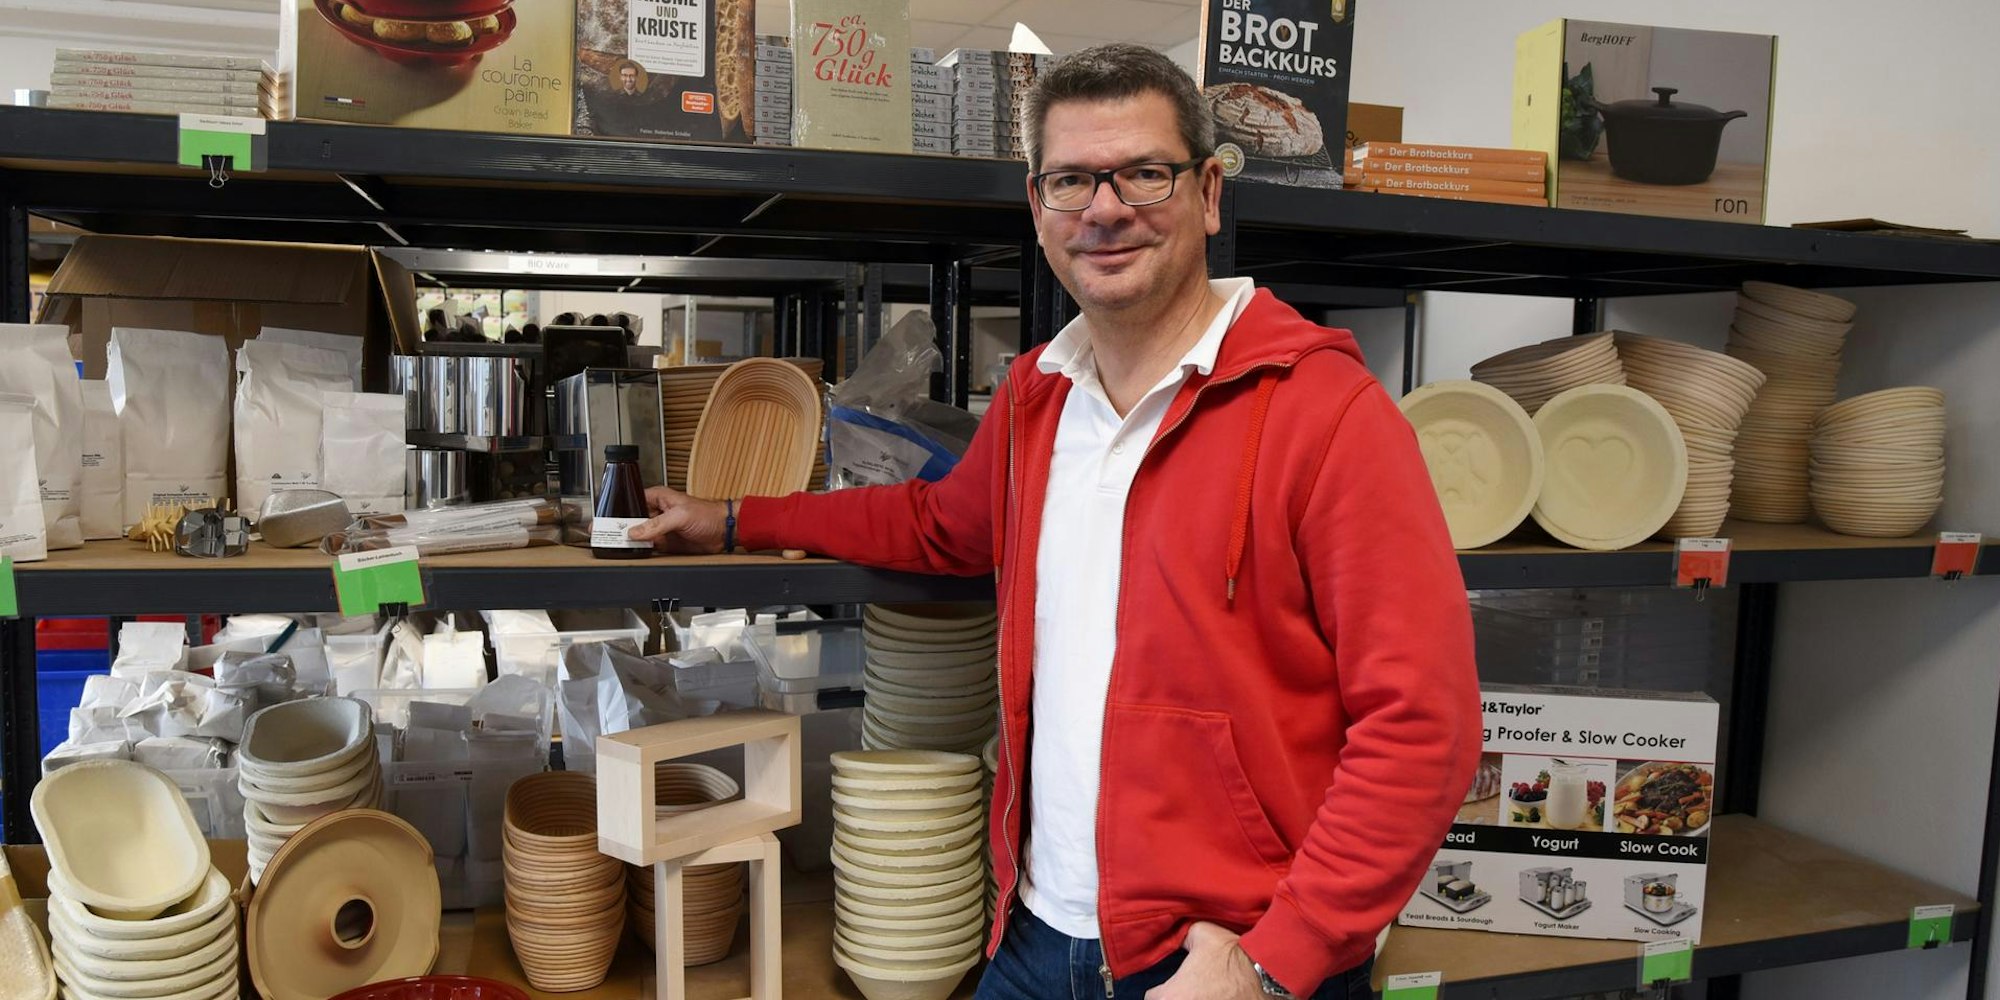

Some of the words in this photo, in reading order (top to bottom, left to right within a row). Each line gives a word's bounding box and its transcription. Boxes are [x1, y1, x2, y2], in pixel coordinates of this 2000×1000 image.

[656, 5, 678, 19] UND
[1223, 0, 1250, 11] DER
[637, 16, 698, 41] KRUSTE
[840, 14, 866, 28] ca.
[1221, 10, 1319, 53] BROT
[1580, 32, 1637, 46] BergHOFF
[812, 22, 867, 58] 750
[862, 49, 876, 71] g
[513, 55, 532, 72] La
[1219, 43, 1338, 79] BACKKURS
[482, 69, 562, 91] couronne
[814, 58, 893, 88] Glück
[504, 87, 539, 106] pain
[1389, 146, 1407, 157] Der
[1409, 148, 1473, 160] Brotbackkurs
[1385, 162, 1402, 172] Der
[1405, 163, 1471, 175] Brotbackkurs
[1386, 178, 1403, 188] Der
[1406, 179, 1470, 192] Brotbackkurs
[1715, 198, 1748, 215] ron
[546, 260, 569, 269] Ware
[1498, 726, 1557, 743] Proofer
[1562, 730, 1572, 743] &
[1579, 730, 1617, 745] Slow
[1622, 732, 1686, 749] Cooker
[1532, 835, 1579, 852] Yogurt
[1620, 840, 1654, 854] Slow
[1657, 842, 1698, 857] Cook
[1425, 914, 1449, 922] Breads
[1456, 916, 1493, 925] Sourdough
[1534, 921, 1557, 930] Yogurt
[1634, 927, 1650, 935] Slow
[1651, 928, 1681, 937] Cooking
